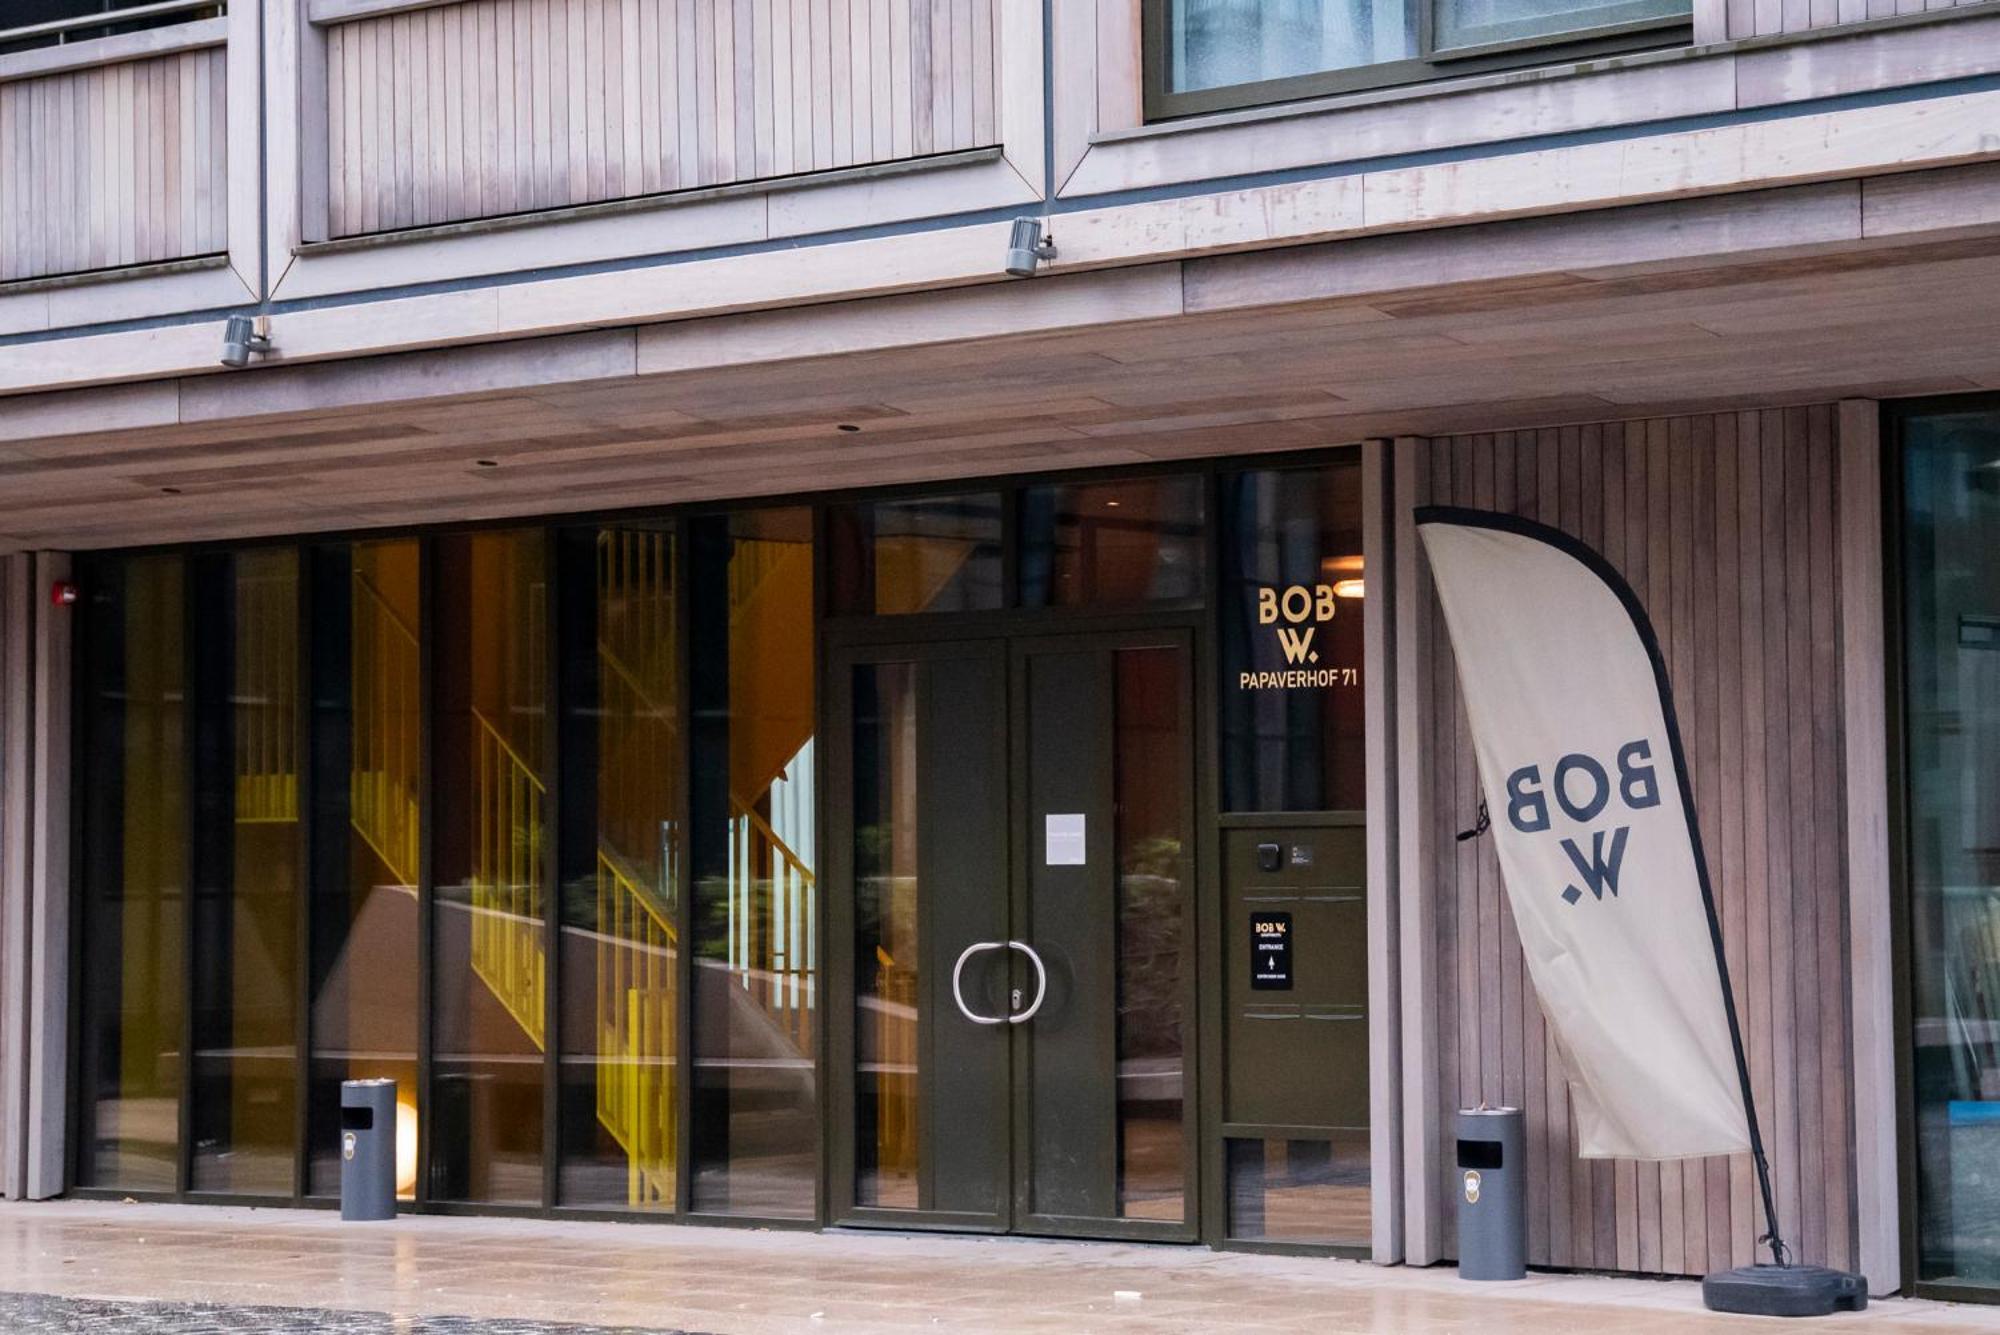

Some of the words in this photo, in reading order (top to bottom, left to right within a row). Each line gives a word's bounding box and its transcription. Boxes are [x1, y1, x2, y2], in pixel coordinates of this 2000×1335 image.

[1259, 584, 1336, 624] BOB
[1277, 627, 1320, 665] W.
[1240, 670, 1339, 690] PAPAVERHOF
[1342, 669, 1357, 686] 71
[1255, 922, 1274, 932] BOB
